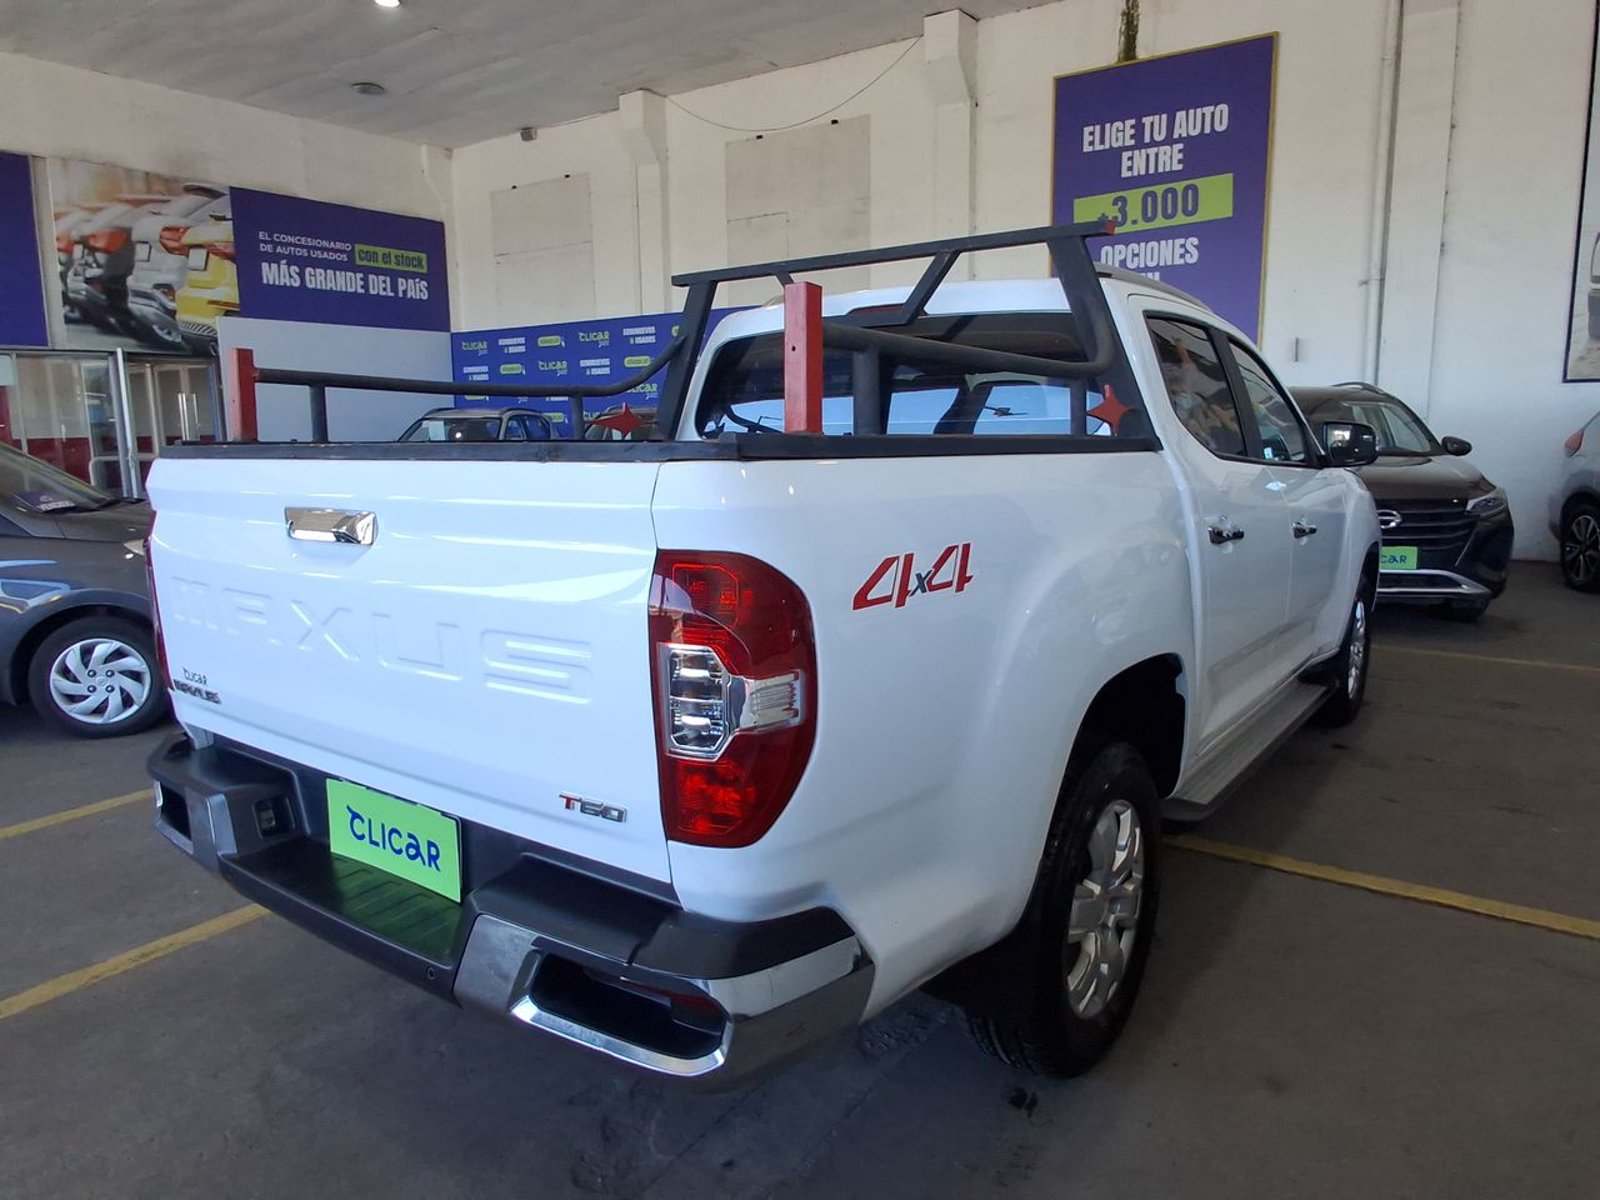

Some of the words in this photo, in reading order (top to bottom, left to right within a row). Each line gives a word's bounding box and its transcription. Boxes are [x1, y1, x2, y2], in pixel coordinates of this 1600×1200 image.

[1083, 119, 1135, 152] ELIGE
[1142, 114, 1167, 143] TU
[1173, 104, 1229, 139] AUTO
[1121, 143, 1184, 178] ENTRE
[259, 231, 271, 241] EL
[273, 233, 352, 251] CONCESIONARIO
[260, 243, 274, 253] DE
[276, 246, 308, 257] AUTOS
[310, 250, 348, 262] USADOS
[1100, 237, 1200, 269] OPCIONES
[358, 249, 379, 264] con
[381, 250, 392, 265] el
[394, 252, 425, 269] stock
[261, 259, 300, 287] MÁS
[305, 267, 365, 294] GRANDE
[369, 274, 394, 297] DEL
[853, 543, 974, 610] 4x4
